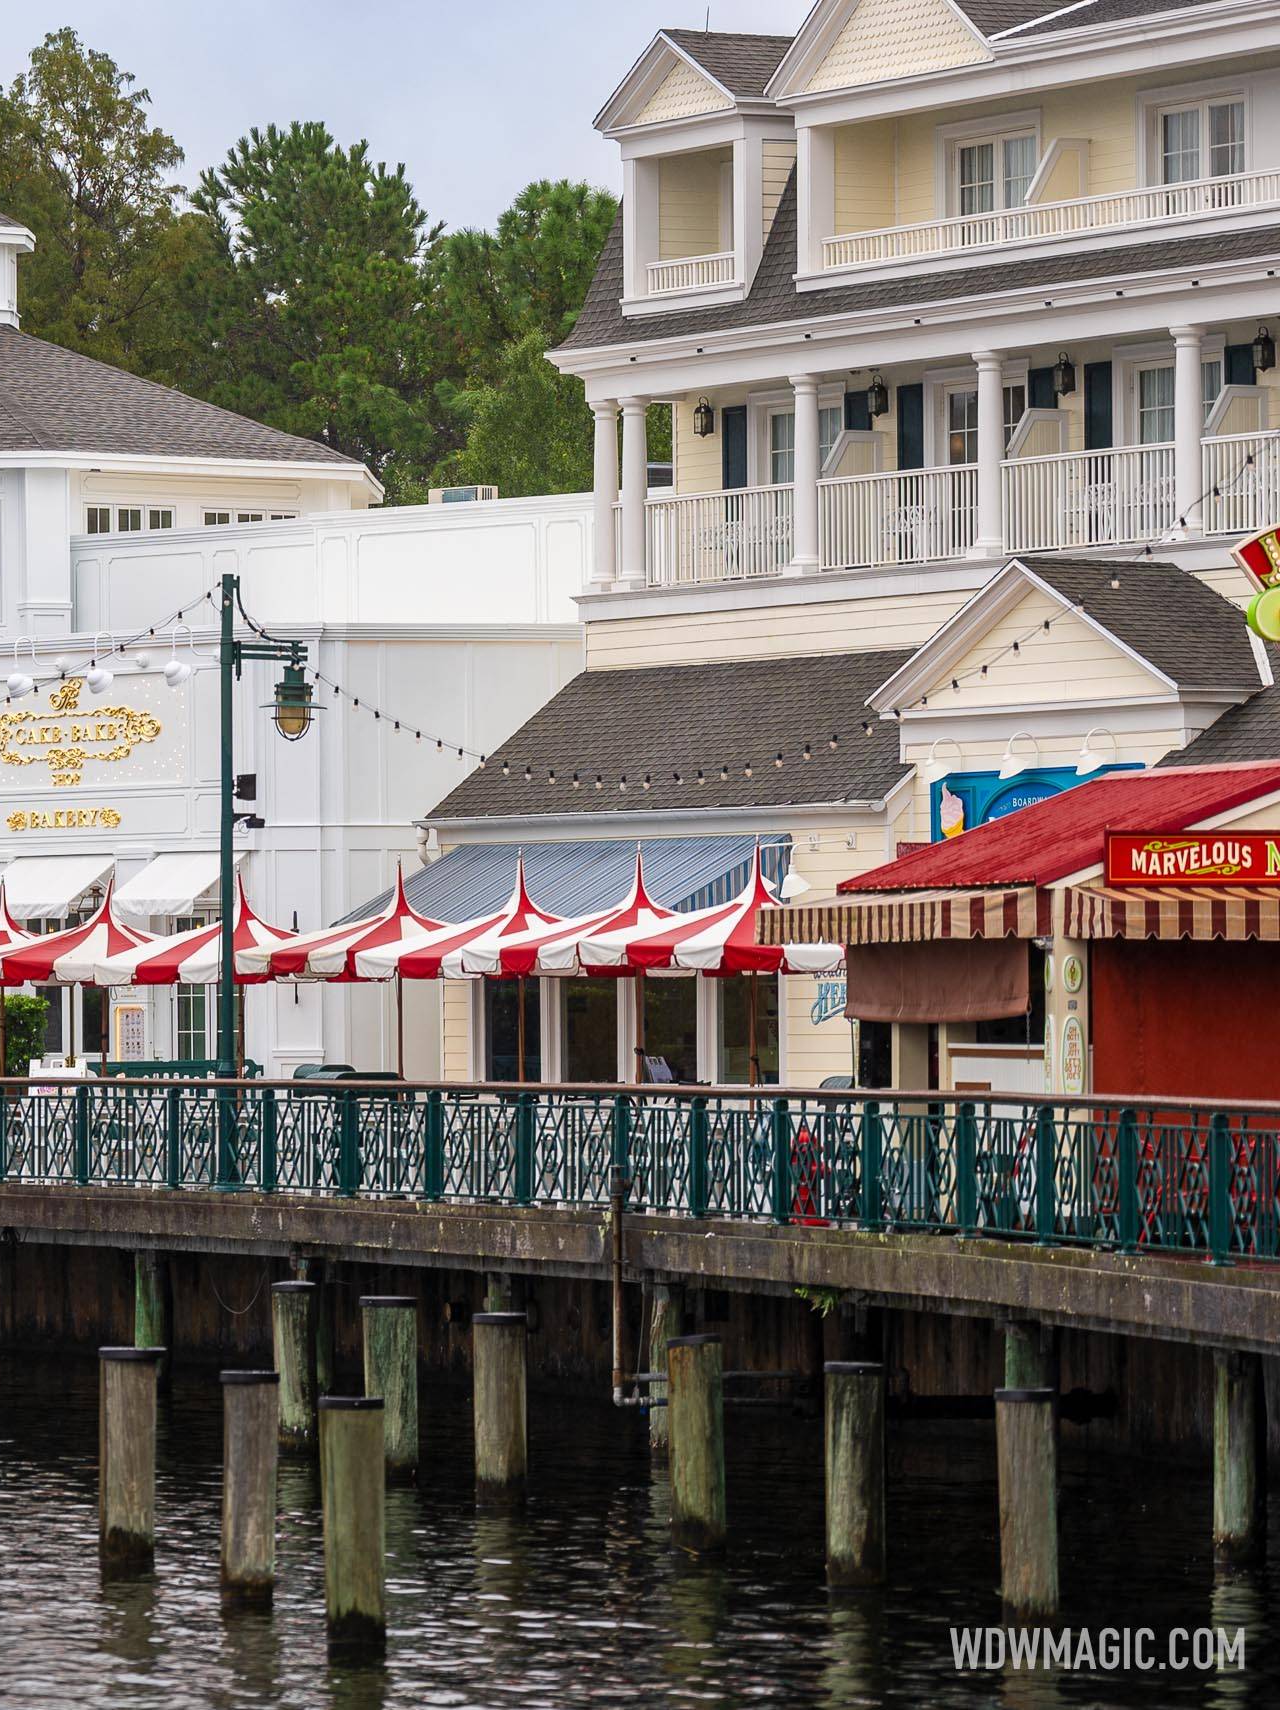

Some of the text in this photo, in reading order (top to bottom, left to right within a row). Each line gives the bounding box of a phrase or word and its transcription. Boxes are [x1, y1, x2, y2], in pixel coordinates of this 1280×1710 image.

[16, 723, 117, 745] CAKE BAKE
[30, 808, 99, 829] BAKERY
[1131, 841, 1252, 876] MARVELOUS
